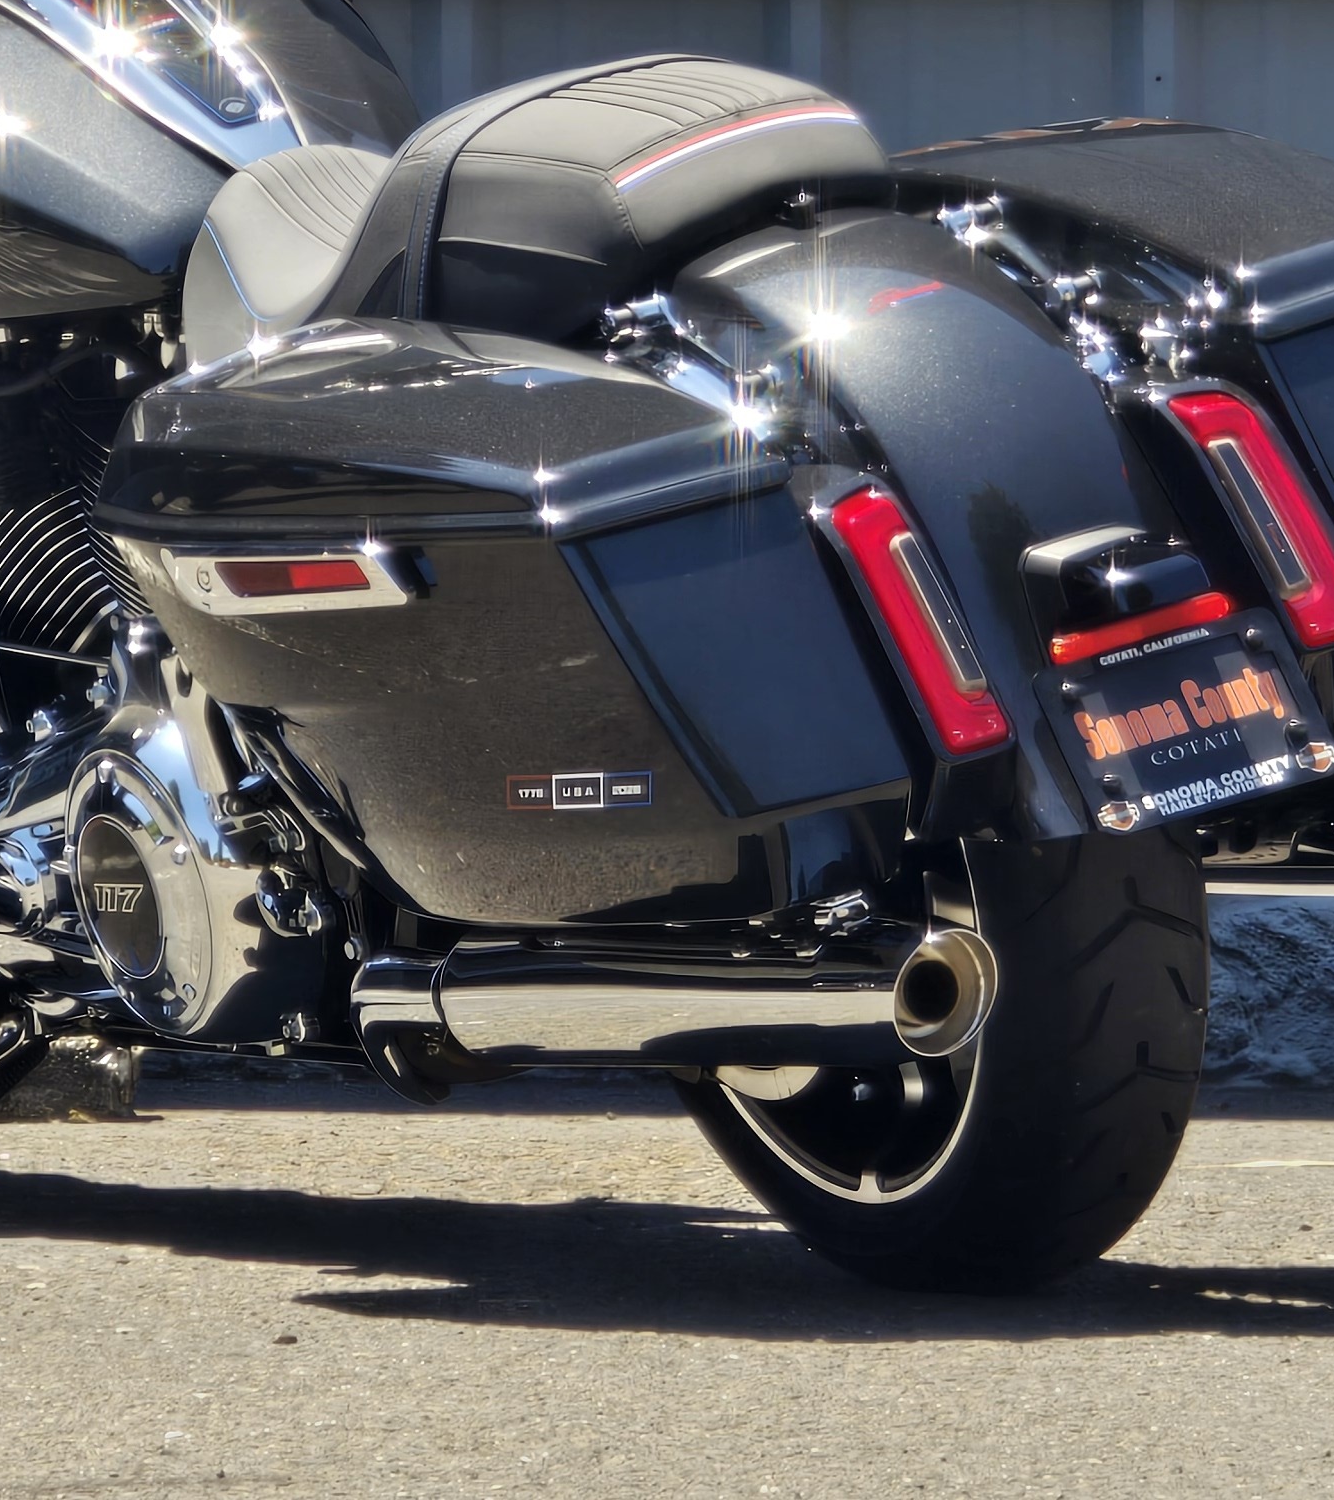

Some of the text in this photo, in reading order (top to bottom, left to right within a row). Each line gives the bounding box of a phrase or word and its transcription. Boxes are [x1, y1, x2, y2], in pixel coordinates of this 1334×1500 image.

[1073, 666, 1285, 760] Sonoma County
[1150, 727, 1242, 765] COTATI
[1141, 754, 1290, 810] SONOMA COUNTY
[93, 883, 144, 913] 117
